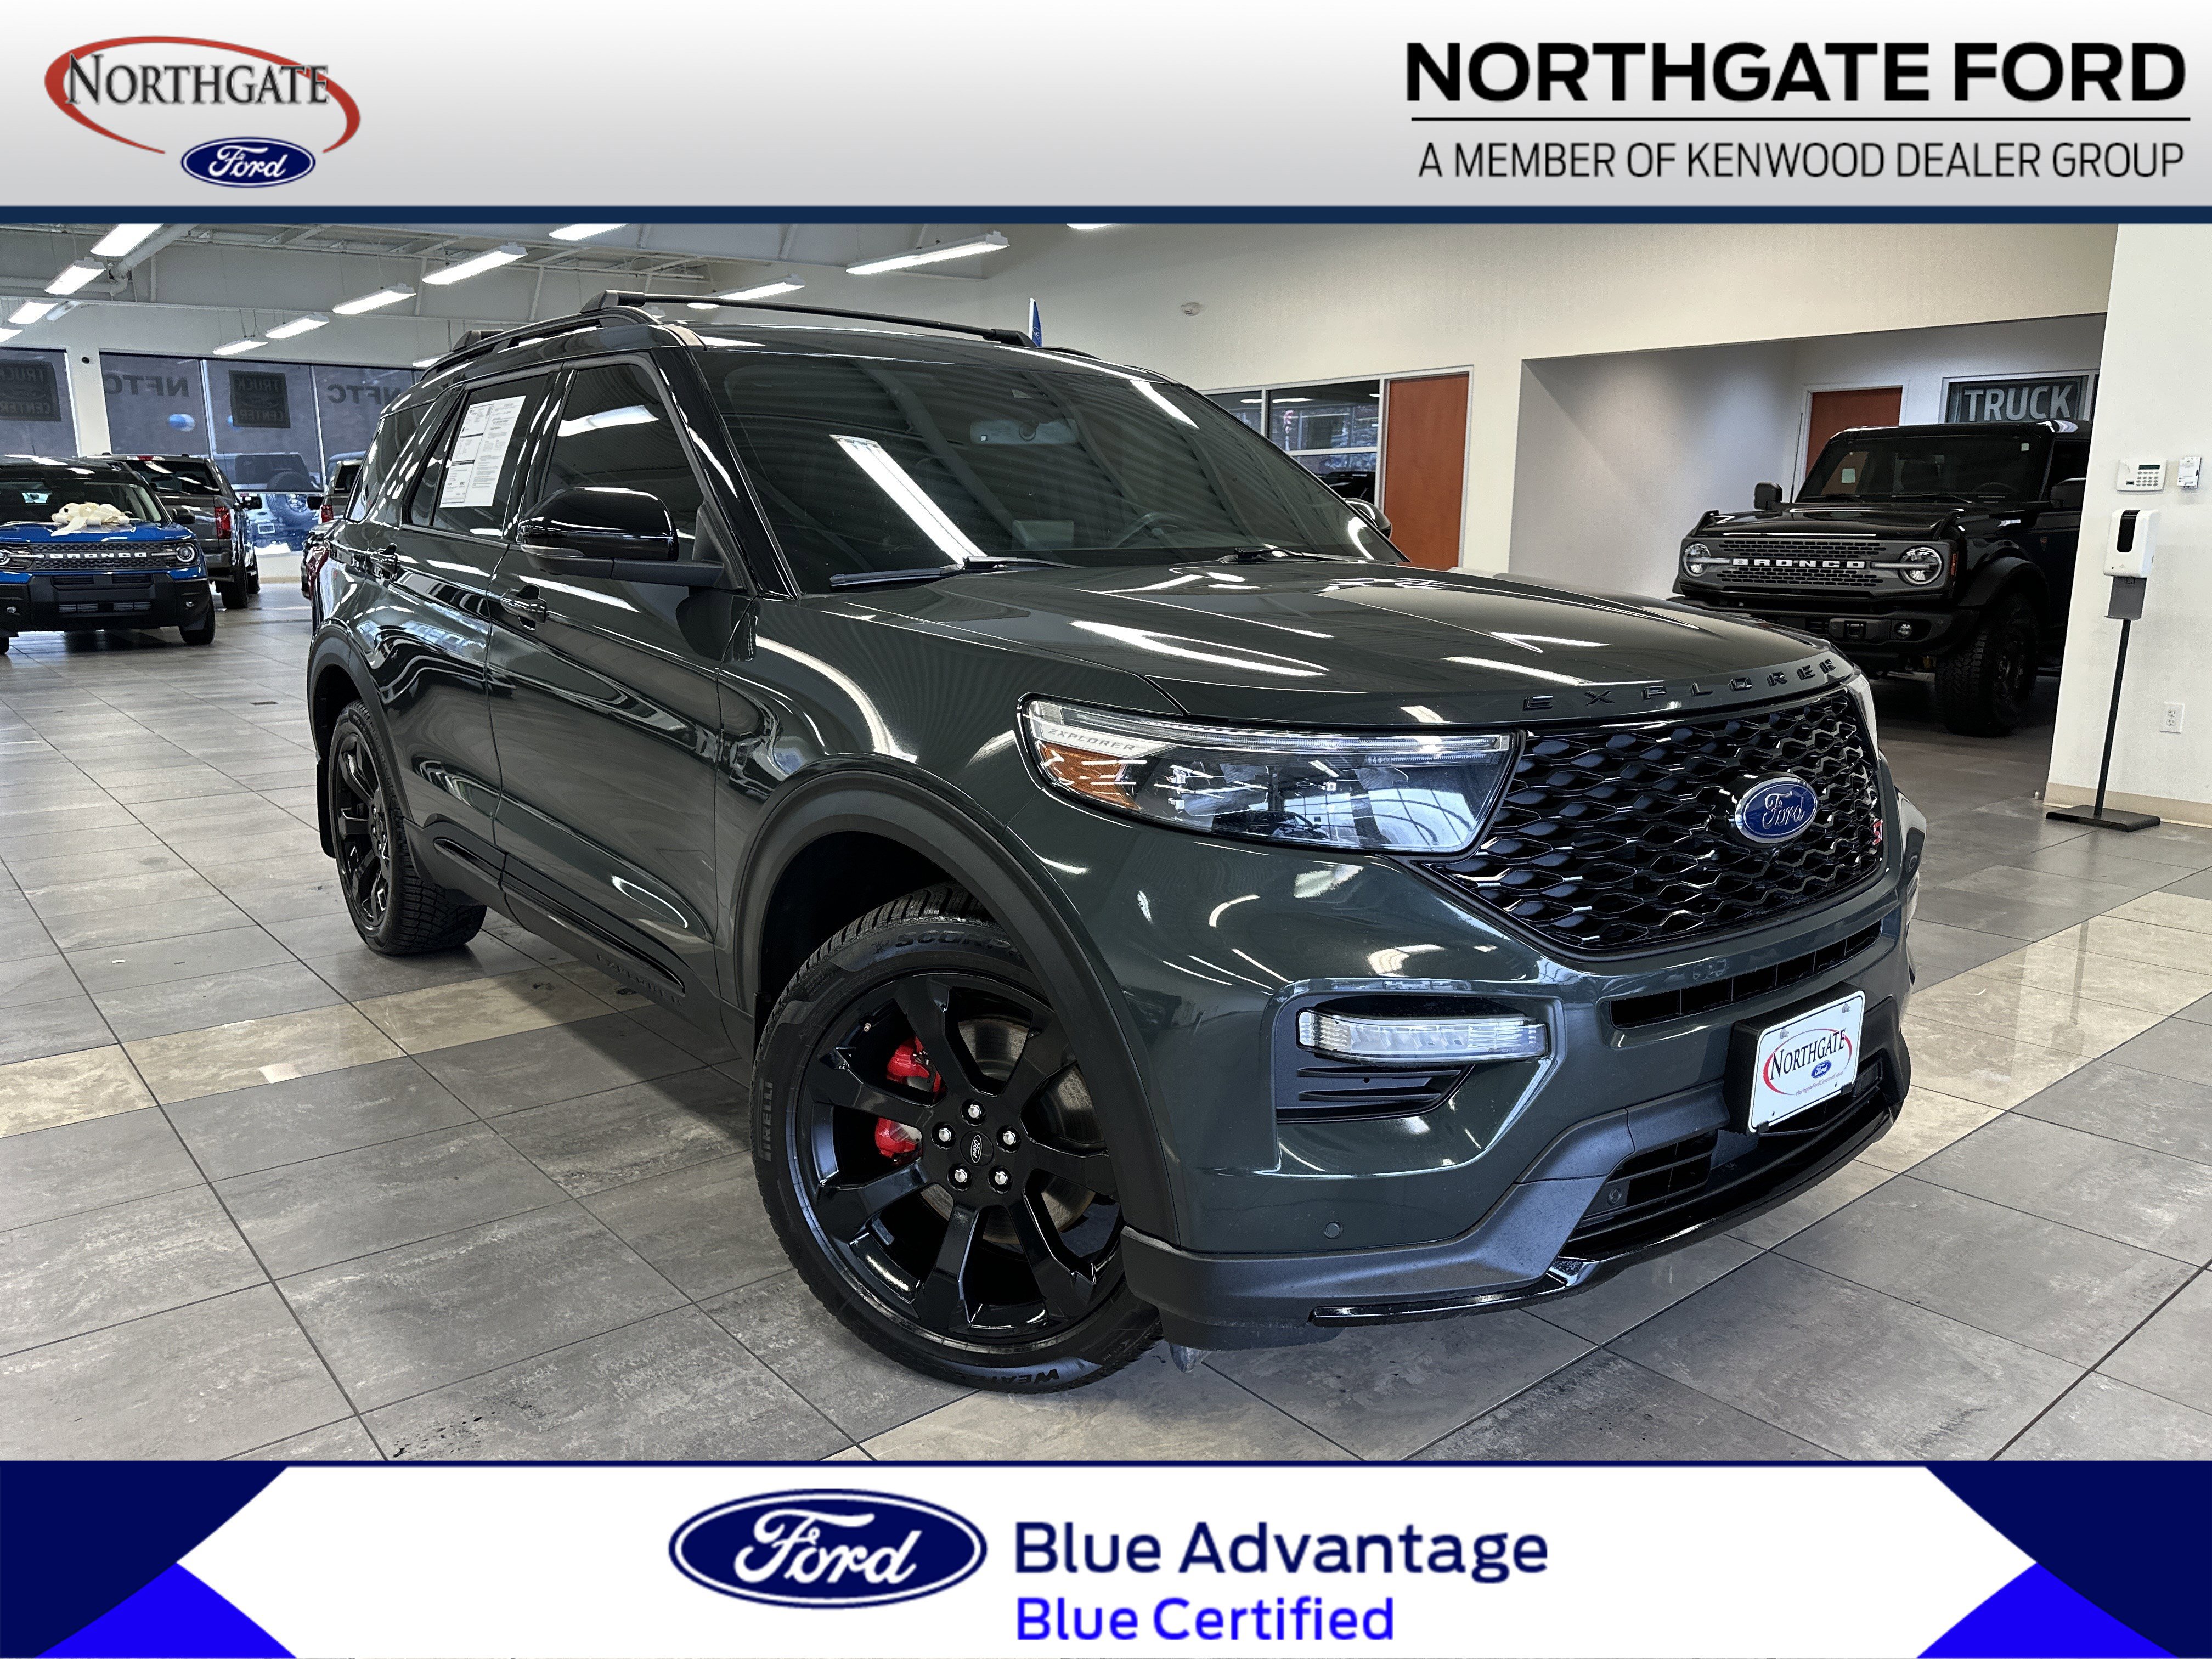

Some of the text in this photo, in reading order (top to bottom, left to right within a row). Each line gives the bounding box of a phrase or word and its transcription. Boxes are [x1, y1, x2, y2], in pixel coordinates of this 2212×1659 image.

[1964, 384, 2074, 422] TRUCK
[1732, 558, 1865, 569] BRONCO
[1523, 658, 1836, 710] EXPLORER
[1048, 728, 1136, 751] EXPLORER
[1762, 791, 1805, 830] Ford
[1770, 1028, 1846, 1081] NORTHGATE
[757, 1077, 774, 1162] PIRELLI
